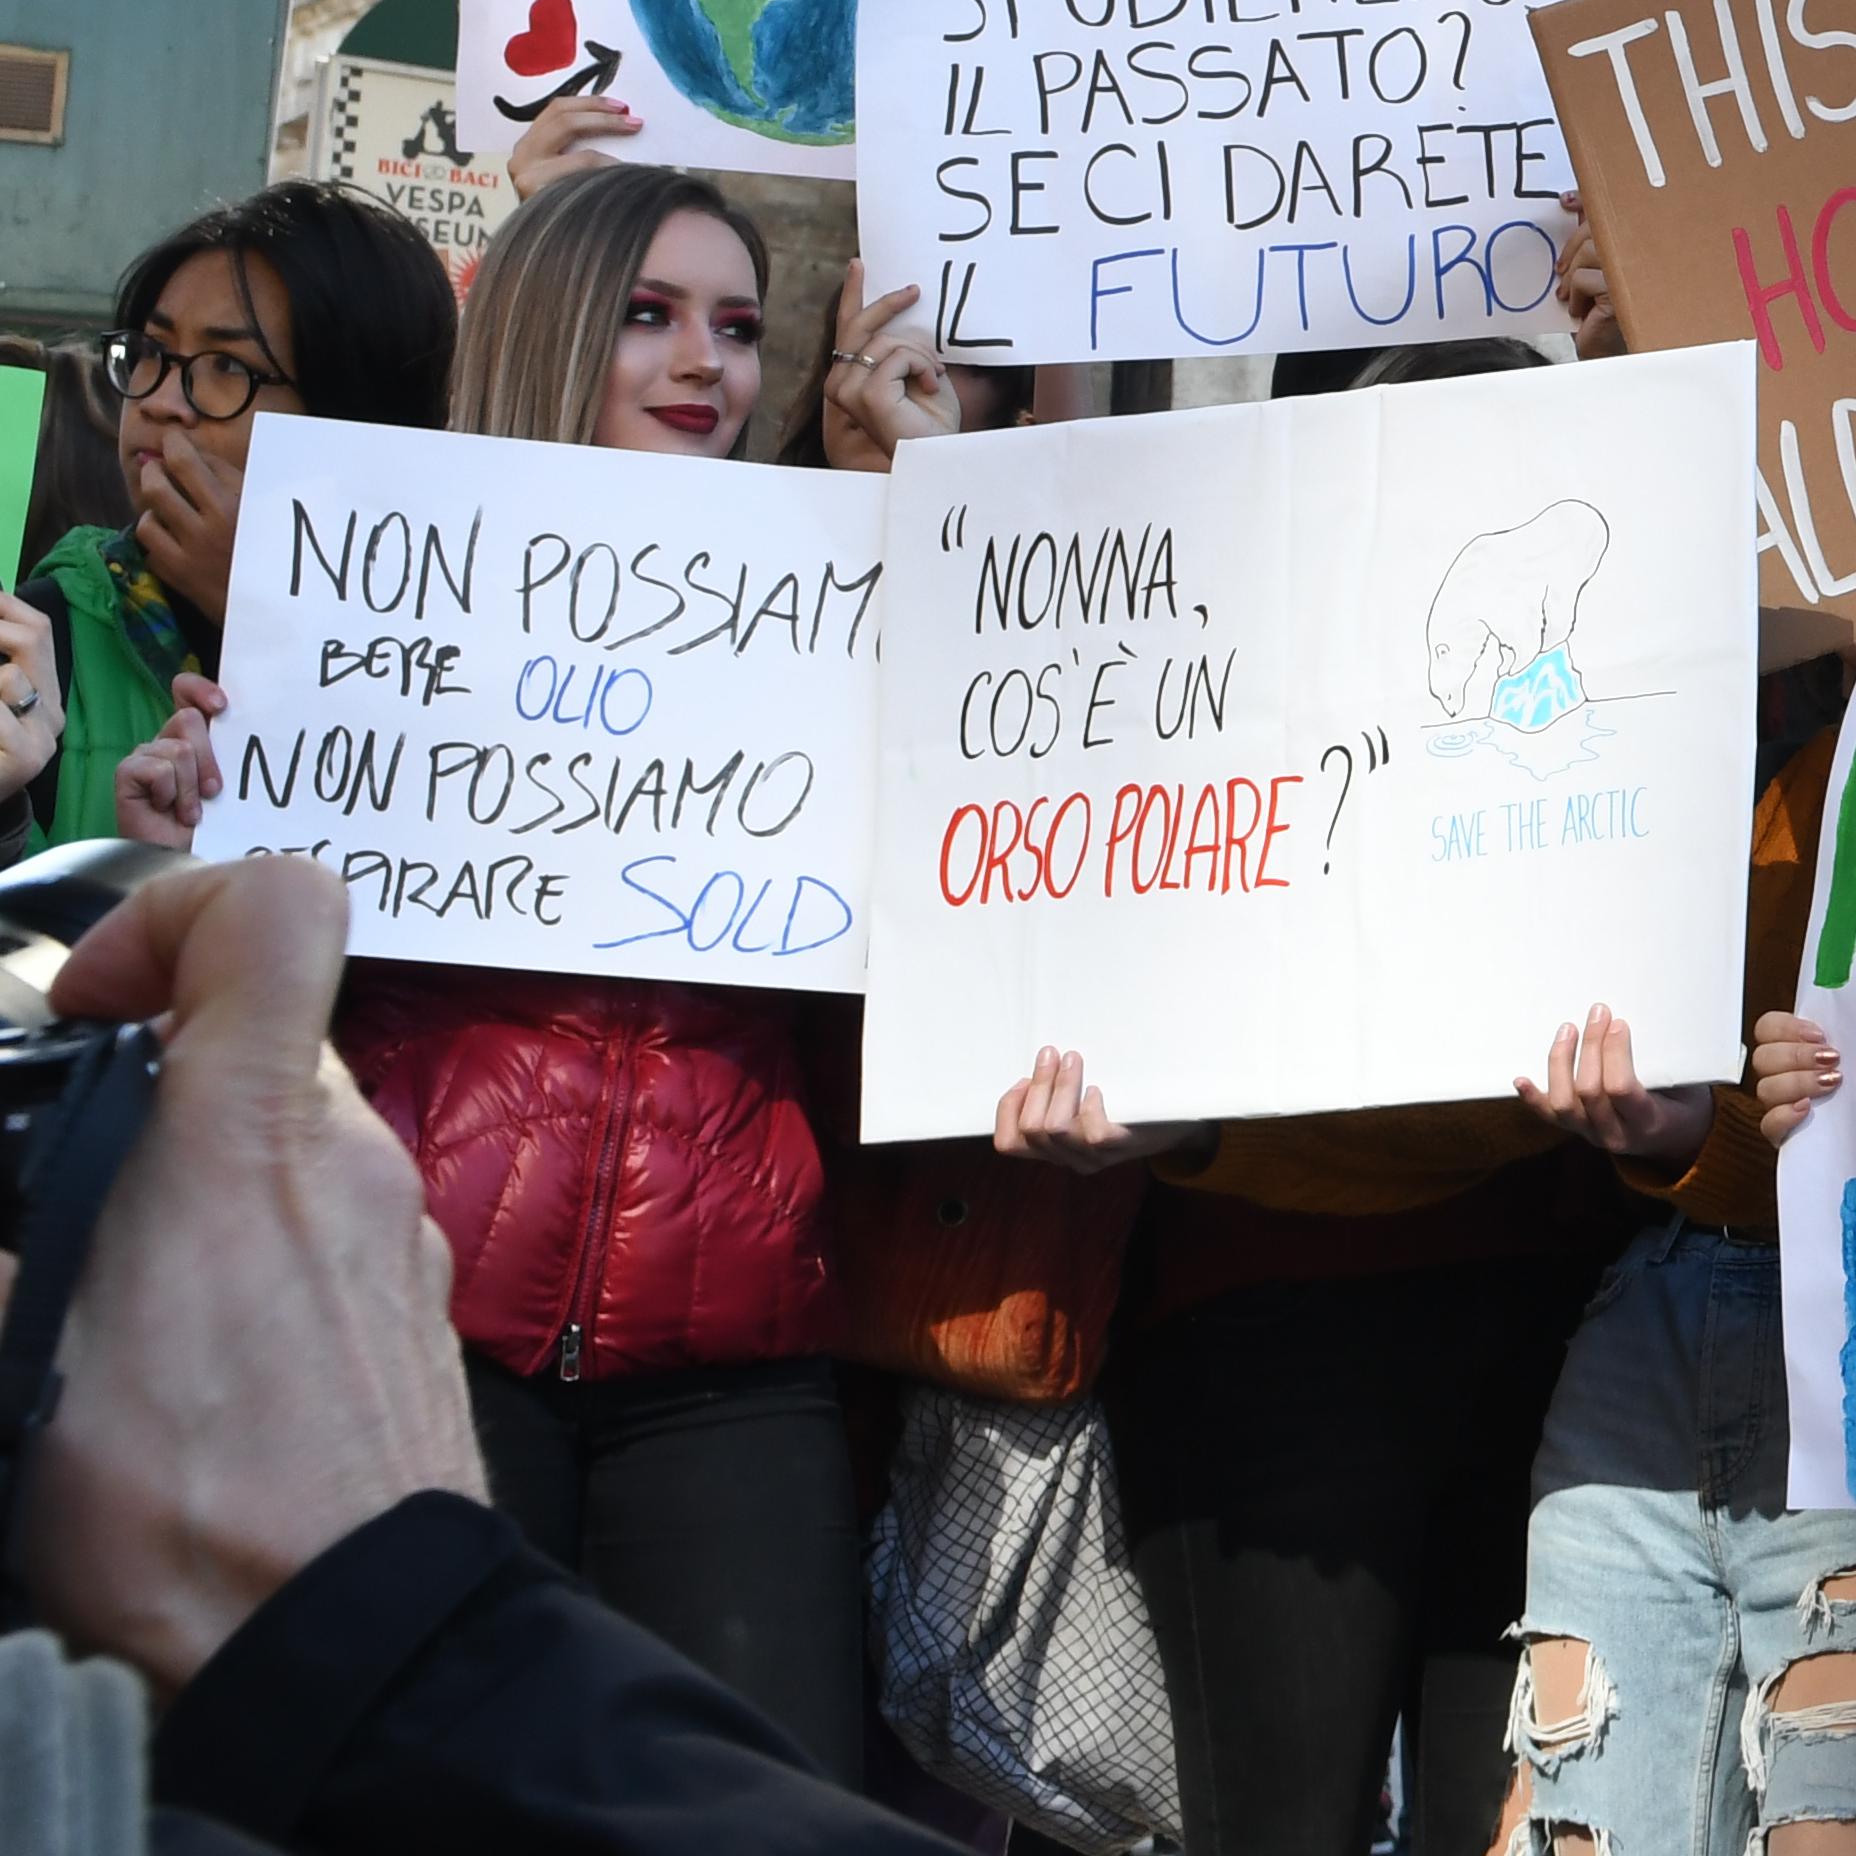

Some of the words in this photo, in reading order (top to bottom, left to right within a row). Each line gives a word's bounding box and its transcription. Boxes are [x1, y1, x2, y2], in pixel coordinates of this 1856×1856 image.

[944, 63, 1012, 137] IL
[1033, 11, 1472, 134] PASSATO?
[378, 158, 421, 179] BICI
[449, 168, 499, 189] BACI
[386, 183, 485, 219] VESPA
[1224, 117, 1561, 230] DARETE
[935, 259, 1014, 355] IL
[1090, 221, 1559, 350] FUTURO
[289, 498, 484, 621] NON
[515, 532, 882, 664] POSSIAM
[319, 636, 473, 706] BERE
[516, 654, 654, 735] OLIO
[1155, 646, 1238, 742] UN
[239, 725, 407, 818] NON
[428, 740, 816, 838] POSSIAMO
[1431, 809, 1488, 864] SAVE
[1500, 800, 1549, 855] THE
[1562, 786, 1651, 847] ARCTIC
[245, 840, 570, 926] PIRARE
[938, 785, 1092, 908] ORSO
